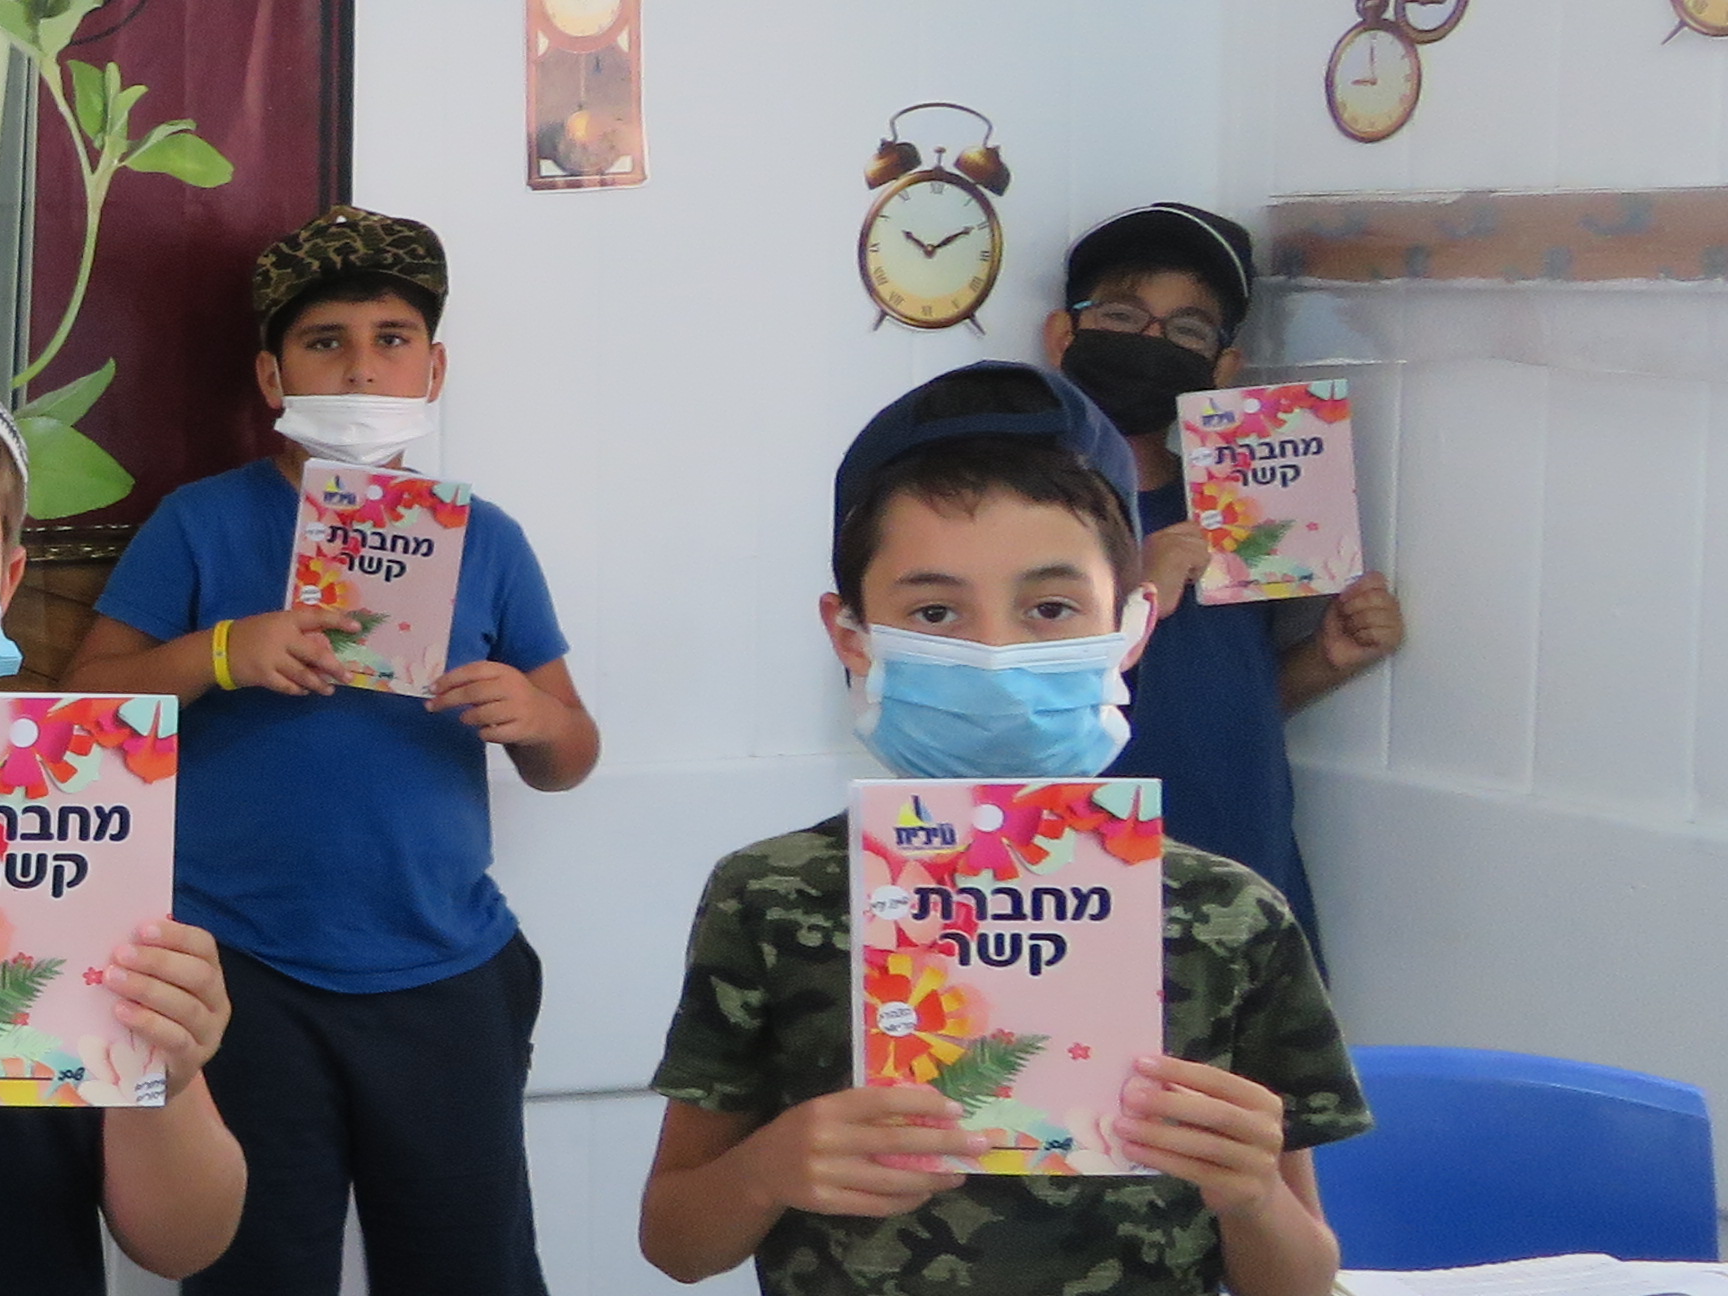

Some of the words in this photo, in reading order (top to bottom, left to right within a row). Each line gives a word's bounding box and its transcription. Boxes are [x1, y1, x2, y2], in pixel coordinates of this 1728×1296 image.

[1214, 436, 1325, 465] מחברת
[1232, 463, 1302, 488] קשר
[326, 525, 435, 558] מחברת
[339, 551, 408, 583] קשר
[911, 886, 1112, 922] מחברת
[939, 932, 1068, 977] קשר
